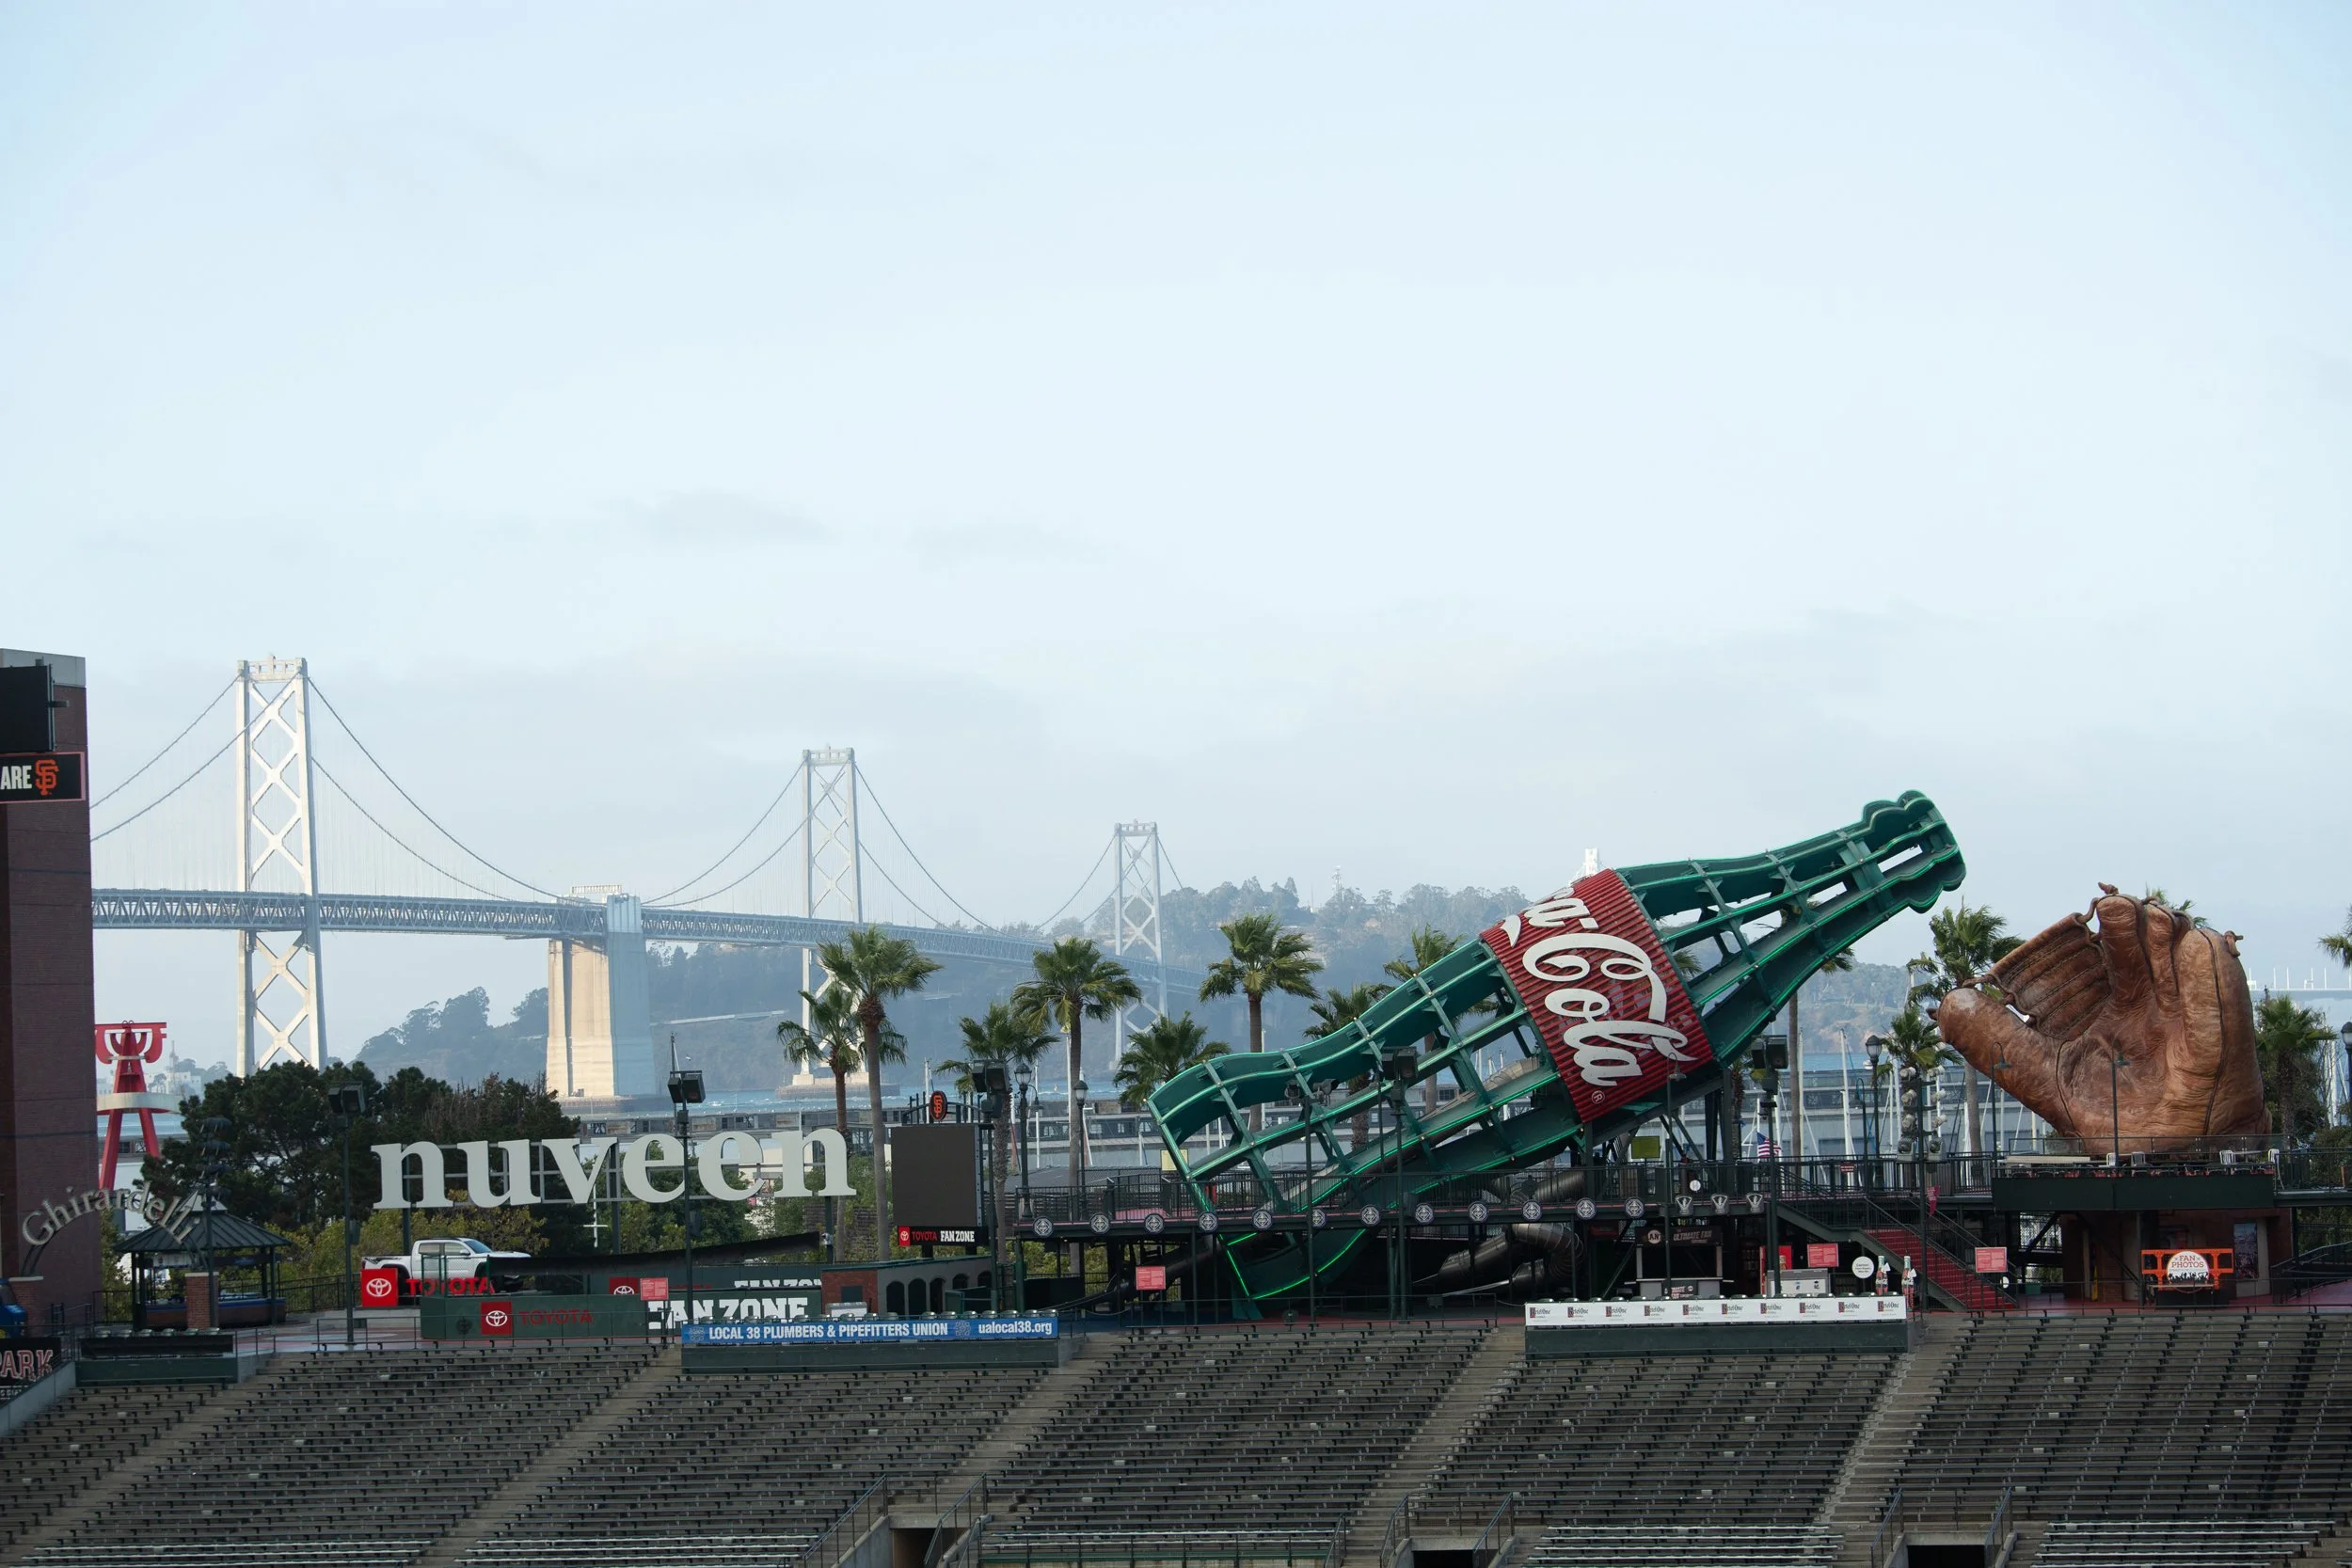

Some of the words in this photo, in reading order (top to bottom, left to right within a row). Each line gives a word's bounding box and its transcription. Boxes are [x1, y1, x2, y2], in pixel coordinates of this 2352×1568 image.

[0, 765, 32, 790] ARE
[371, 1129, 856, 1210] nuveen
[22, 1180, 200, 1245] Ghirardelli
[911, 1231, 938, 1241] TOYOTA
[940, 1230, 955, 1242] FAN
[955, 1230, 975, 1242] ZONE
[518, 1309, 593, 1325] TOYOTA
[647, 1299, 714, 1329] FAN
[719, 1297, 808, 1323] ZONE
[708, 1326, 744, 1340] LOCAL
[746, 1326, 760, 1339] 38
[763, 1324, 824, 1339] PLUMBERS
[827, 1324, 835, 1338] &
[838, 1323, 910, 1338] PIPEFITTERS
[912, 1322, 948, 1337] UNION
[978, 1320, 1052, 1335] ualocal38.org
[0, 1349, 54, 1382] ARK
